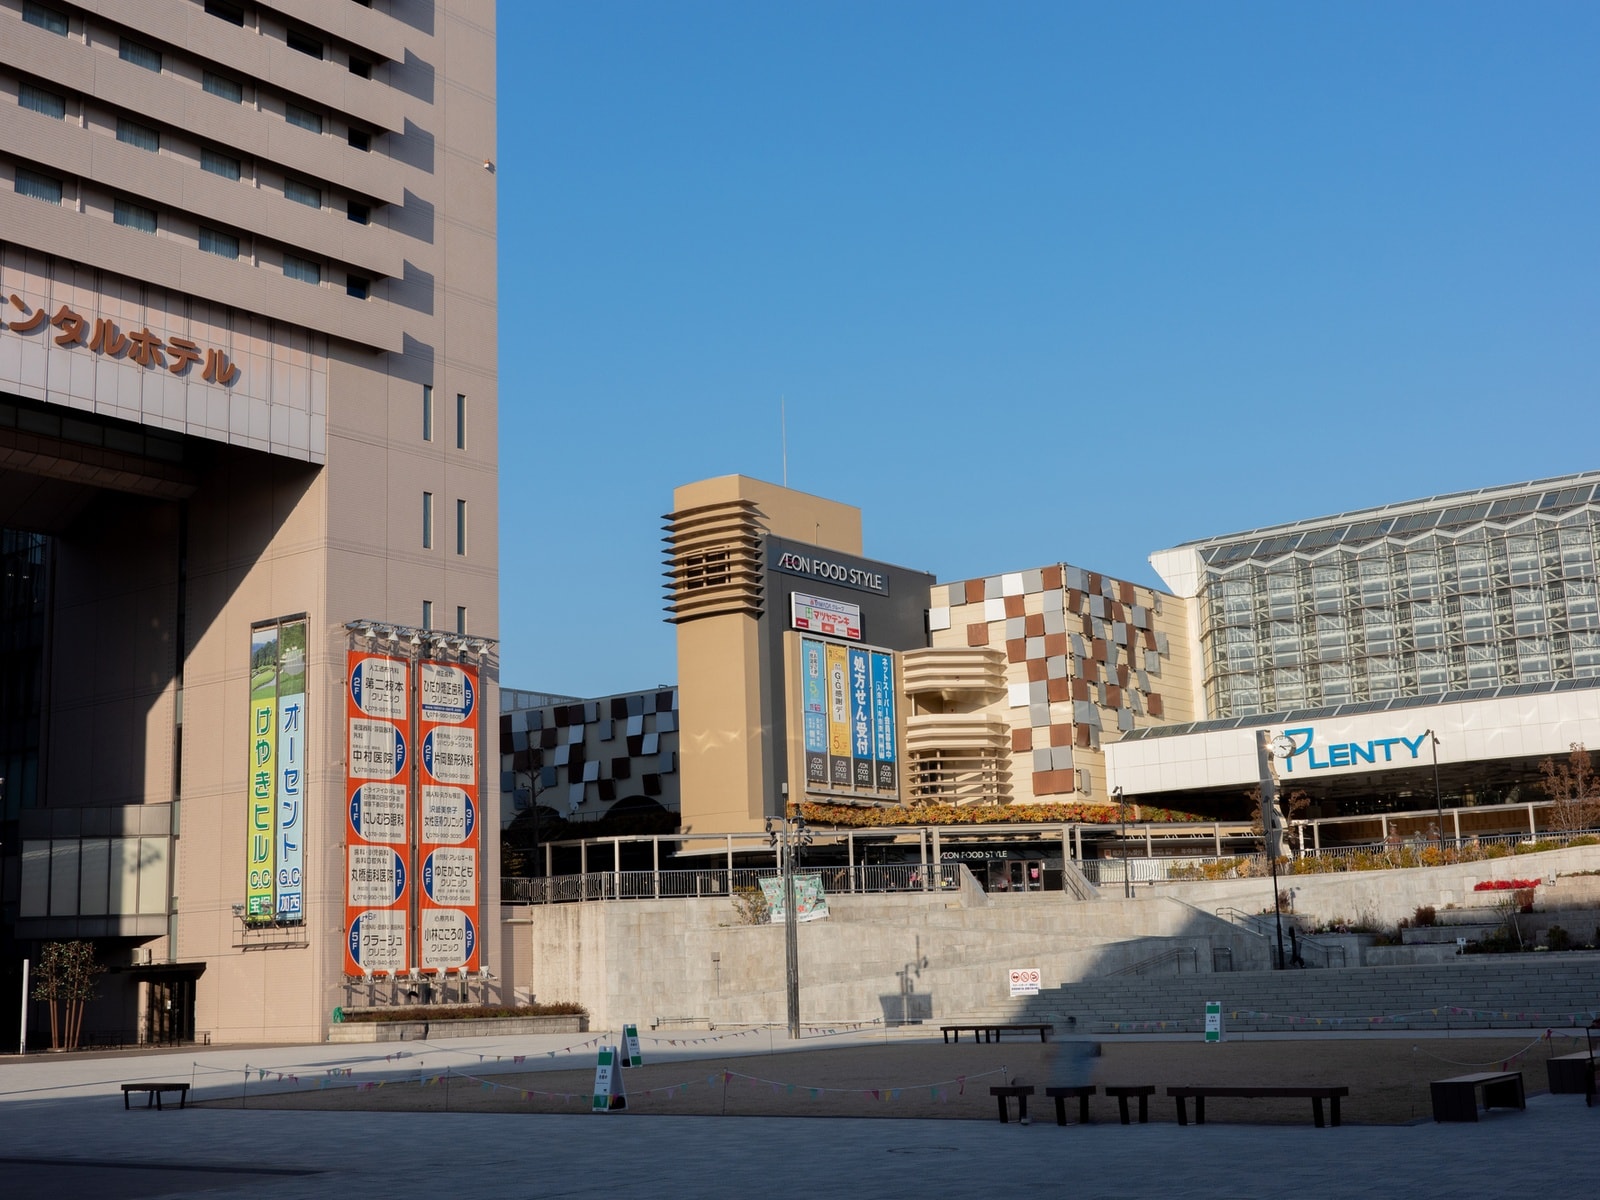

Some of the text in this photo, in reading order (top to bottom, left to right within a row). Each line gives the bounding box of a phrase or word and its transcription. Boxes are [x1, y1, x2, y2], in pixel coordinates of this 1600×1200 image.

[0, 294, 235, 383] ンタルホテル
[813, 559, 847, 581] FOOD
[849, 568, 883, 590] STYLE
[371, 693, 400, 703] クリニック
[431, 695, 459, 705] クリニック
[853, 655, 869, 755] 処方せん受付
[353, 750, 393, 764] 中村医院
[1284, 728, 1425, 772] PLENTY
[253, 706, 271, 863] けやきヒル
[282, 703, 300, 862] オーセント
[363, 812, 404, 827] にしむら眼科
[961, 851, 984, 859] FOOD
[985, 850, 1008, 858] STYLE
[434, 865, 473, 878] ゆたかこども
[440, 879, 468, 888] クリニック
[362, 934, 403, 947] クラージュ
[424, 928, 464, 942] 小林こころの
[368, 948, 398, 957] クリニック
[431, 943, 459, 952] クリニック
